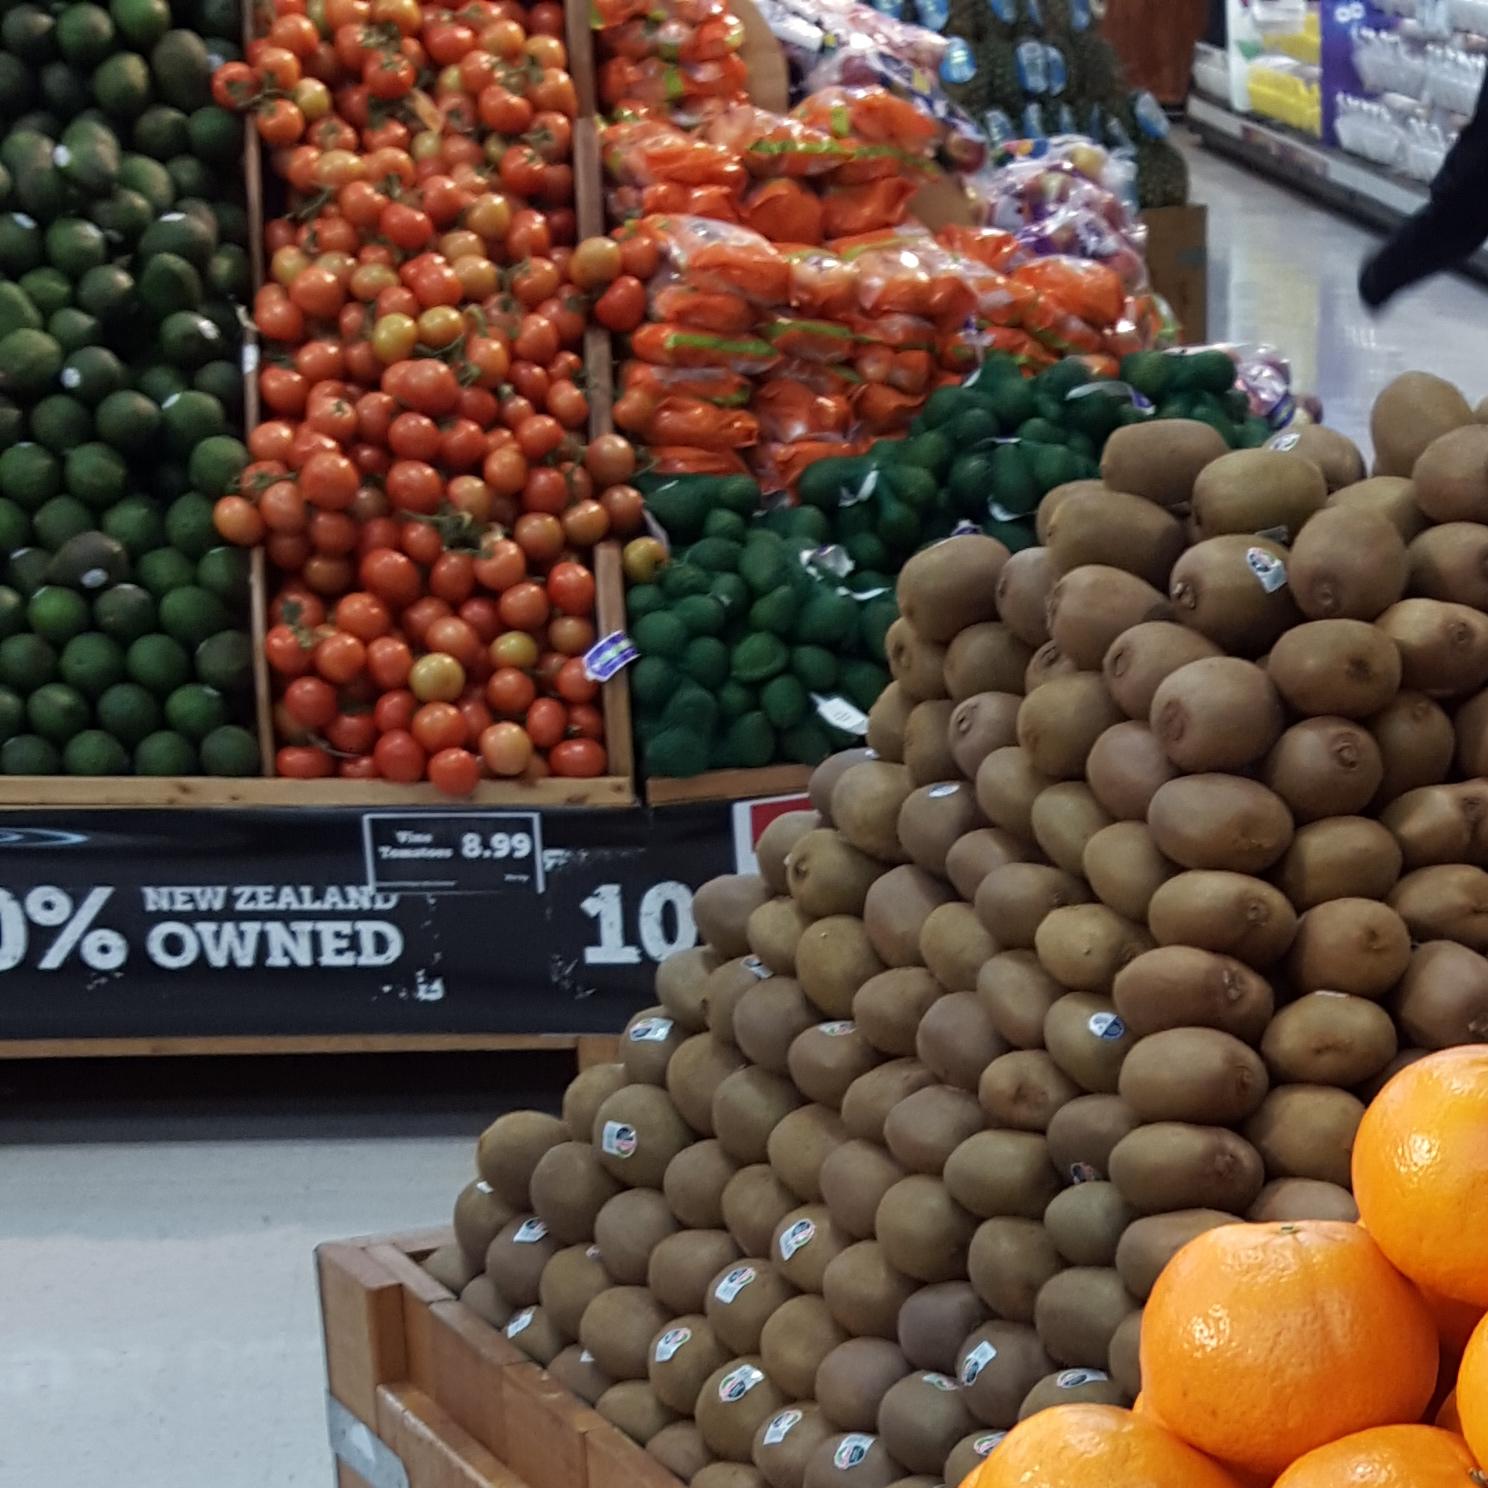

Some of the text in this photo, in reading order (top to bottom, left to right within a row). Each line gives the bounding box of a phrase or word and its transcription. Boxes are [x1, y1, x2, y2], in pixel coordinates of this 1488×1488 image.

[461, 832, 533, 859] 8.99
[141, 885, 400, 912] NEW ZEALAND
[146, 920, 405, 968] OWNED
